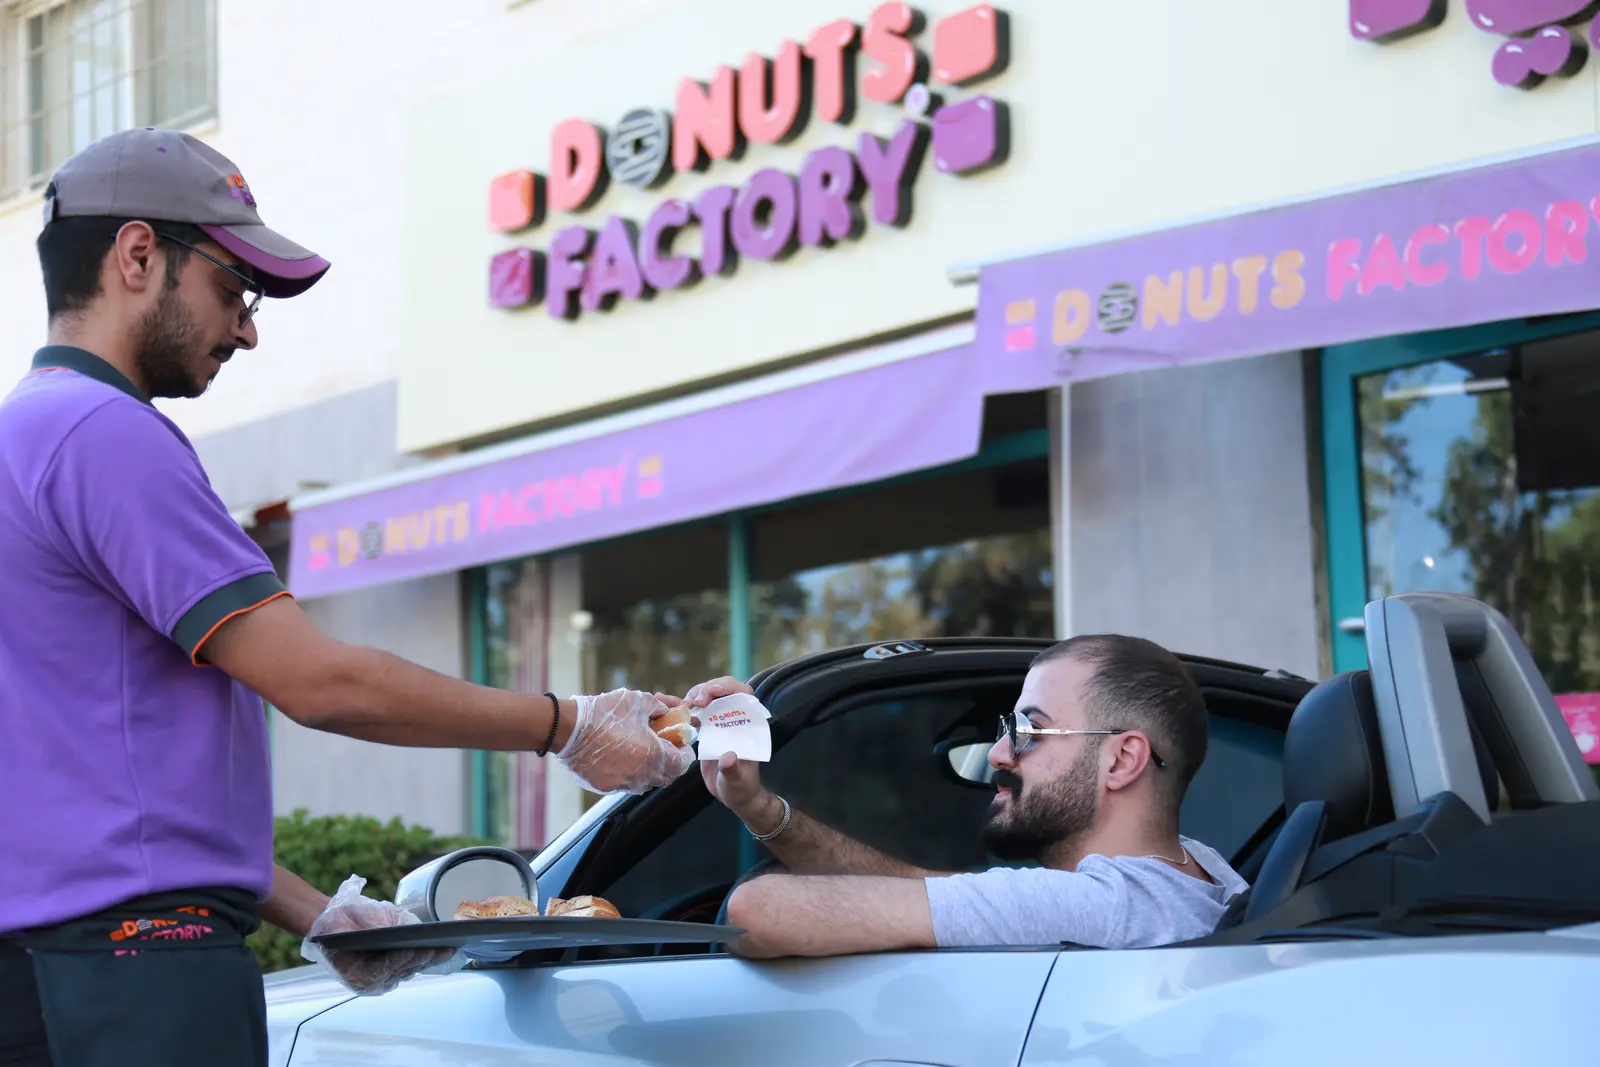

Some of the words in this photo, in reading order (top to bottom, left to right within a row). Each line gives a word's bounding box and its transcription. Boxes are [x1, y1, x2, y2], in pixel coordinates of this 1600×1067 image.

[547, 1, 914, 211] DONUTS
[546, 119, 918, 319] FACTORY
[1052, 250, 1306, 344] DONUTS
[337, 501, 471, 566] DONUTS
[480, 455, 630, 532] FACTORY
[713, 710, 741, 721] DONUTS
[720, 718, 746, 728] FACTORY
